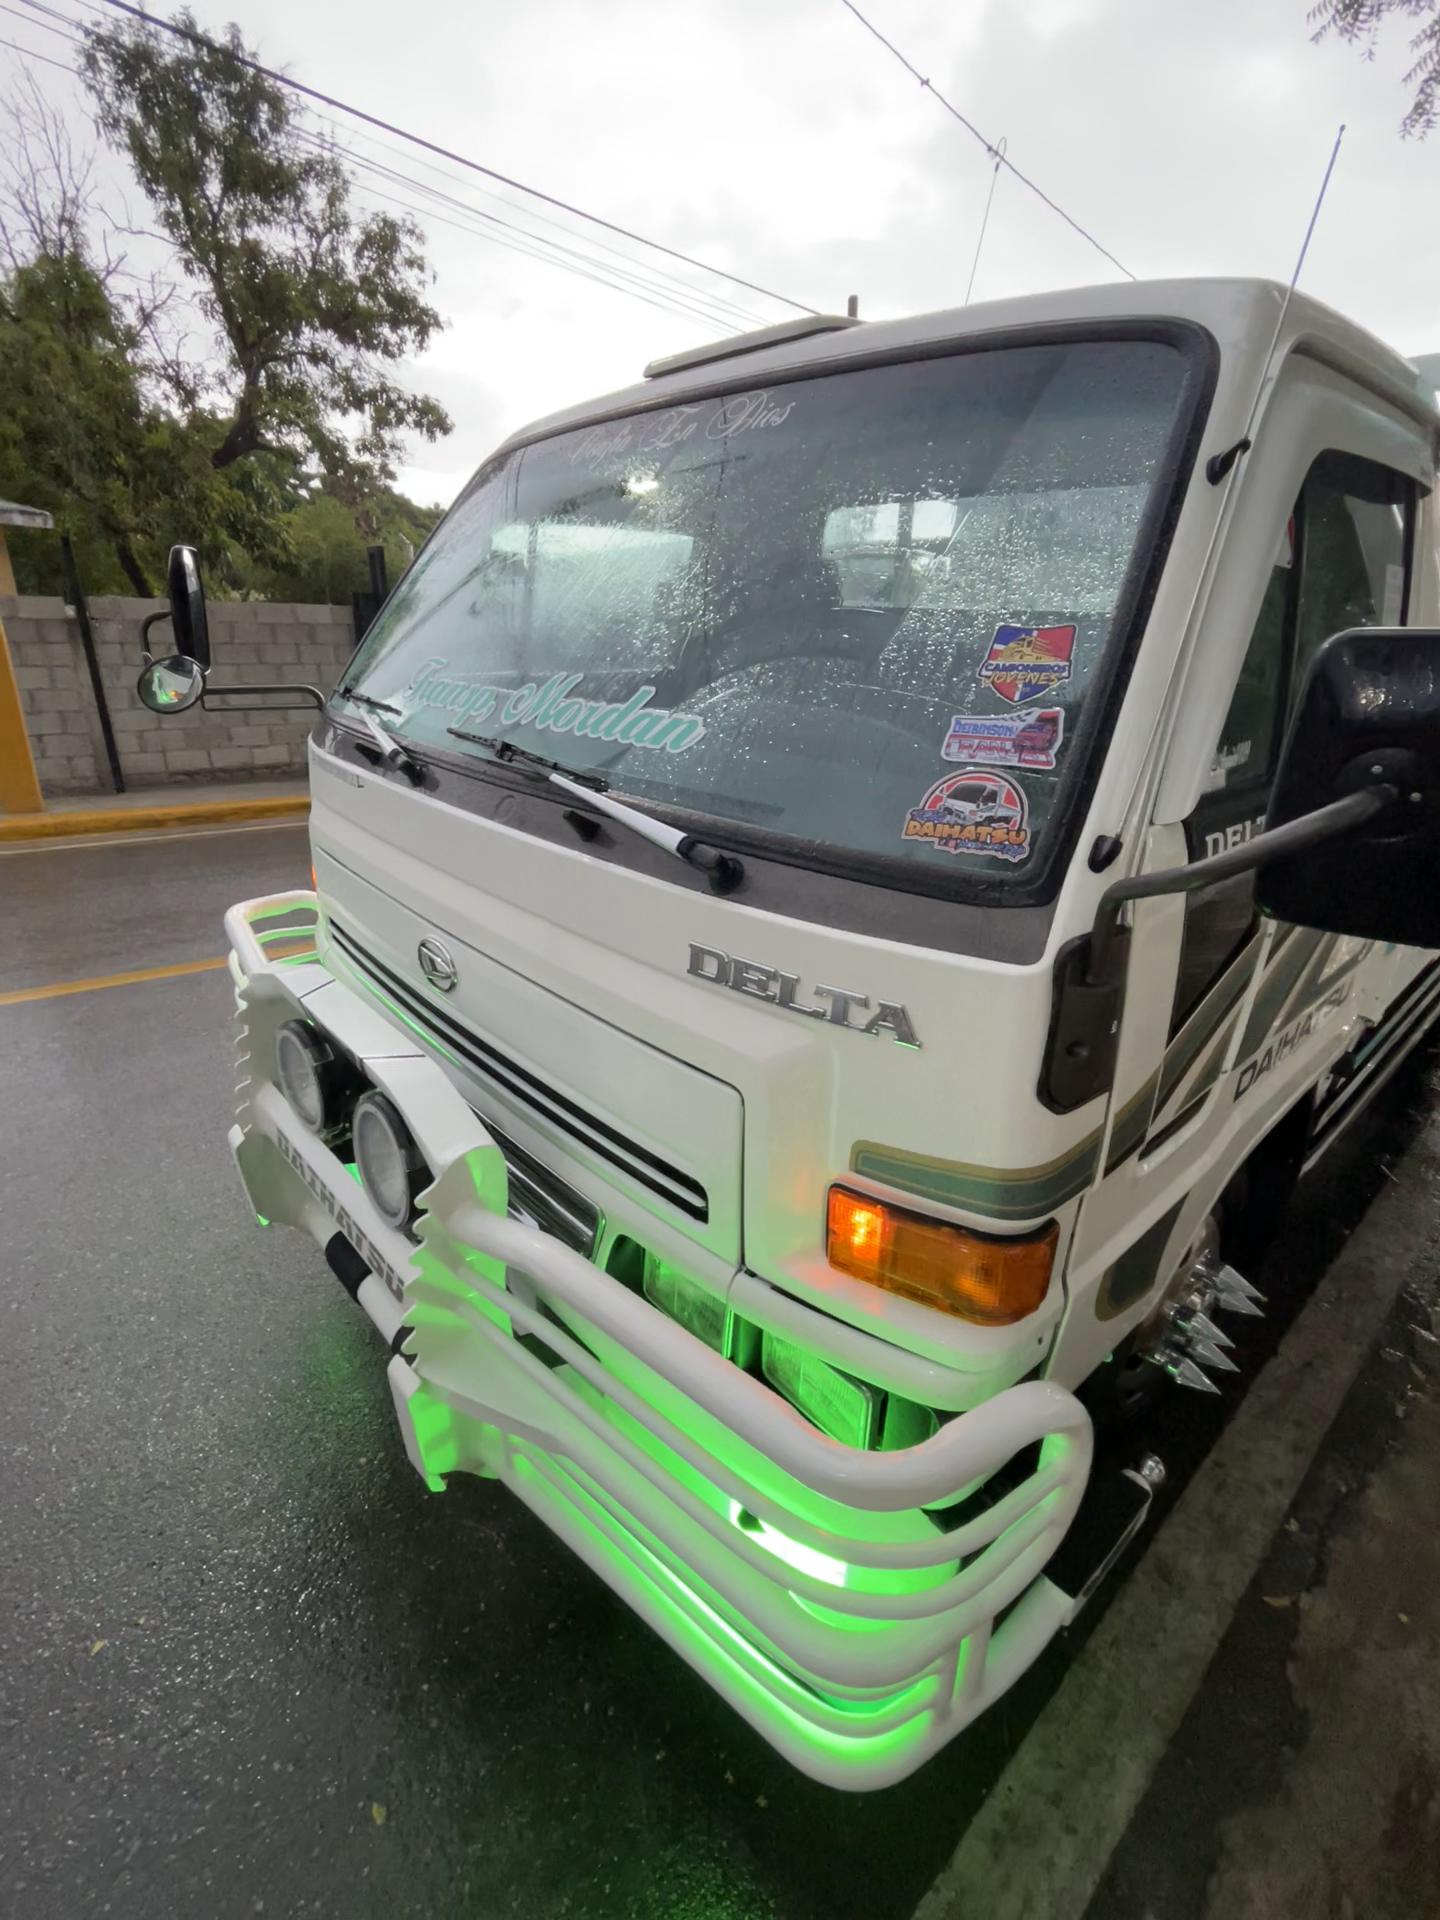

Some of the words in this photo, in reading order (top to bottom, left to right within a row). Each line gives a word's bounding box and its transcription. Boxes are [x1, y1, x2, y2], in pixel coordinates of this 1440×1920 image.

[705, 389, 796, 440] Dios
[501, 671, 706, 754] Mordan
[981, 670, 1059, 689] JOVENES
[904, 819, 1027, 846] DAIHATSU
[687, 939, 922, 1050] DELTA
[277, 1126, 406, 1304] DAIHATSU
